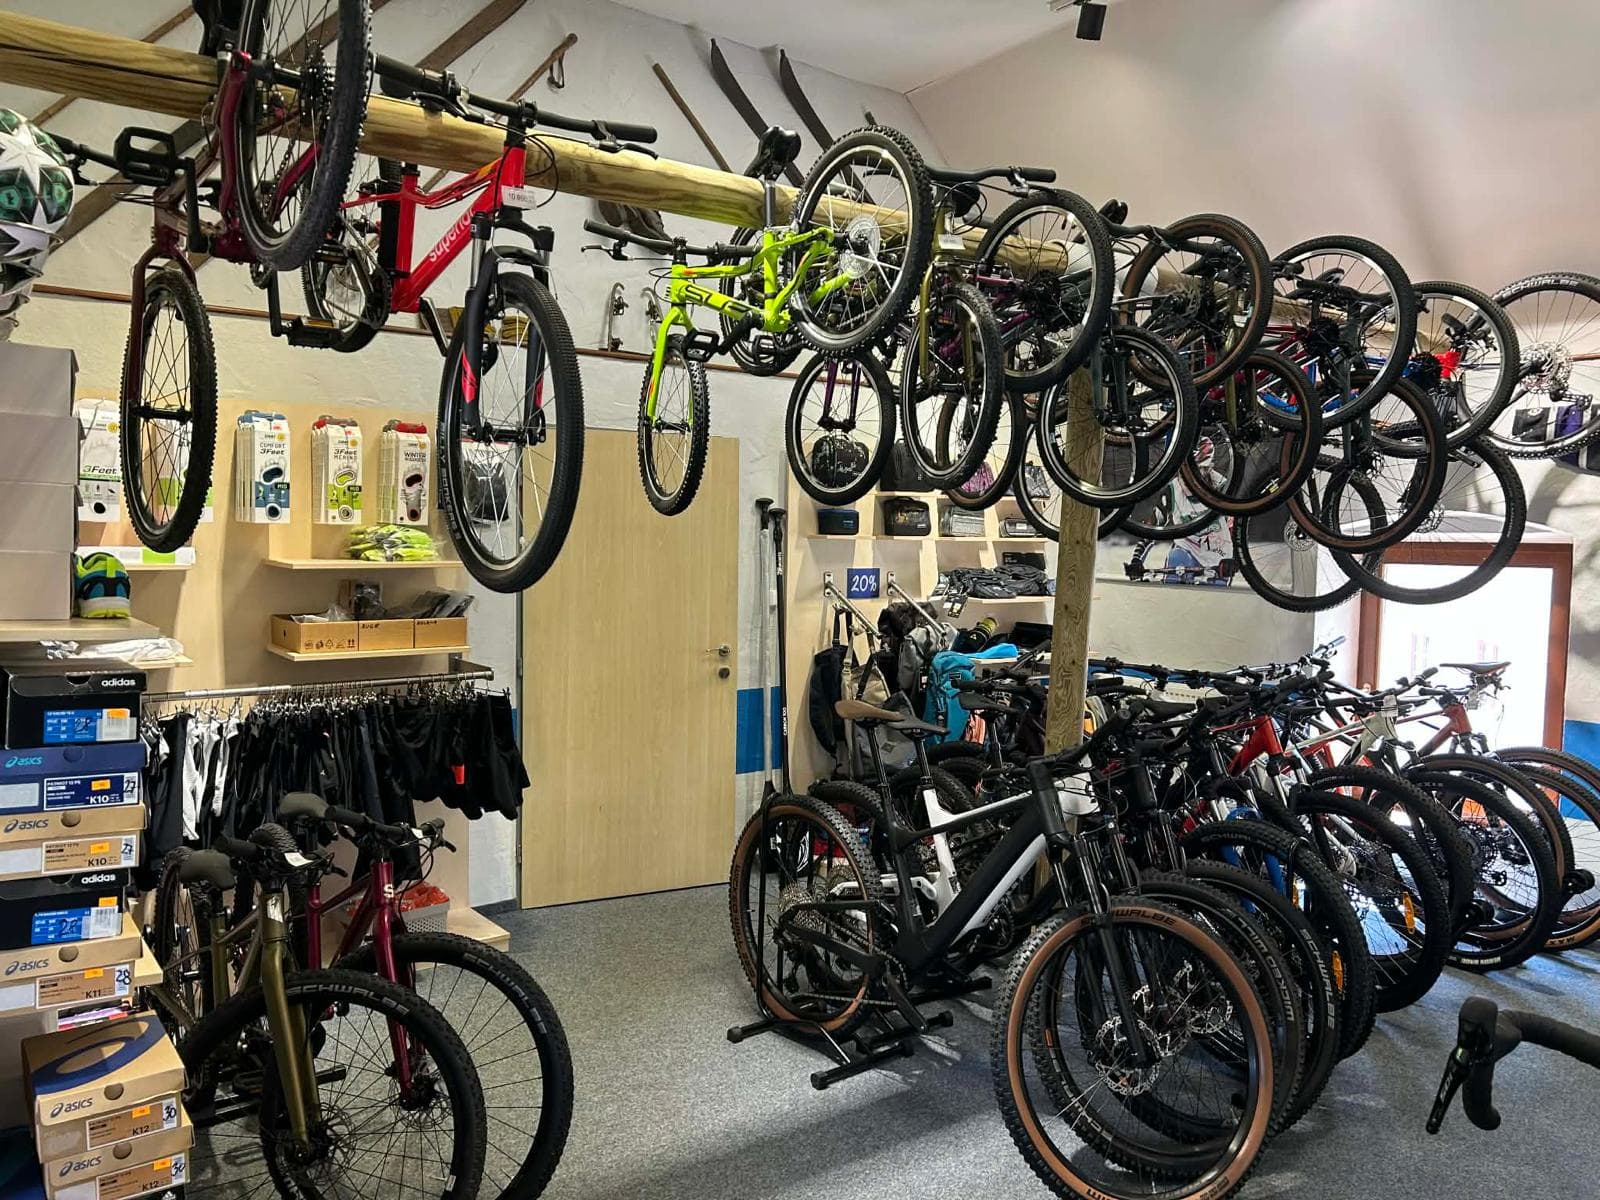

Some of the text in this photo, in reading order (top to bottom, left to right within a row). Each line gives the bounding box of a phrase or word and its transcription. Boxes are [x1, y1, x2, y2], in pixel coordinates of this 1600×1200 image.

[1502, 278, 1579, 298] SCHWALBE
[333, 448, 357, 456] 3Feet
[83, 465, 118, 474] 3Feet
[851, 574, 877, 592] 20%
[101, 677, 136, 687] adidas
[17, 756, 43, 766] asics
[123, 779, 136, 794] 27
[89, 795, 109, 804] K10
[18, 819, 48, 830] asics
[121, 843, 134, 855] 27
[87, 858, 107, 867] K10
[81, 873, 116, 884] adidas
[1080, 909, 1177, 926] SWALBE
[20, 959, 49, 970] asics
[116, 969, 131, 985] 28
[1300, 928, 1336, 1030] SCHWALBE
[85, 989, 102, 999] K11
[1265, 955, 1294, 1022] WICKED
[286, 984, 410, 1016] SCHWALBE
[64, 1098, 93, 1113] asics
[163, 1106, 176, 1122] 30
[132, 1125, 150, 1136] K12
[73, 1156, 102, 1171] asics
[142, 1181, 159, 1192] K12
